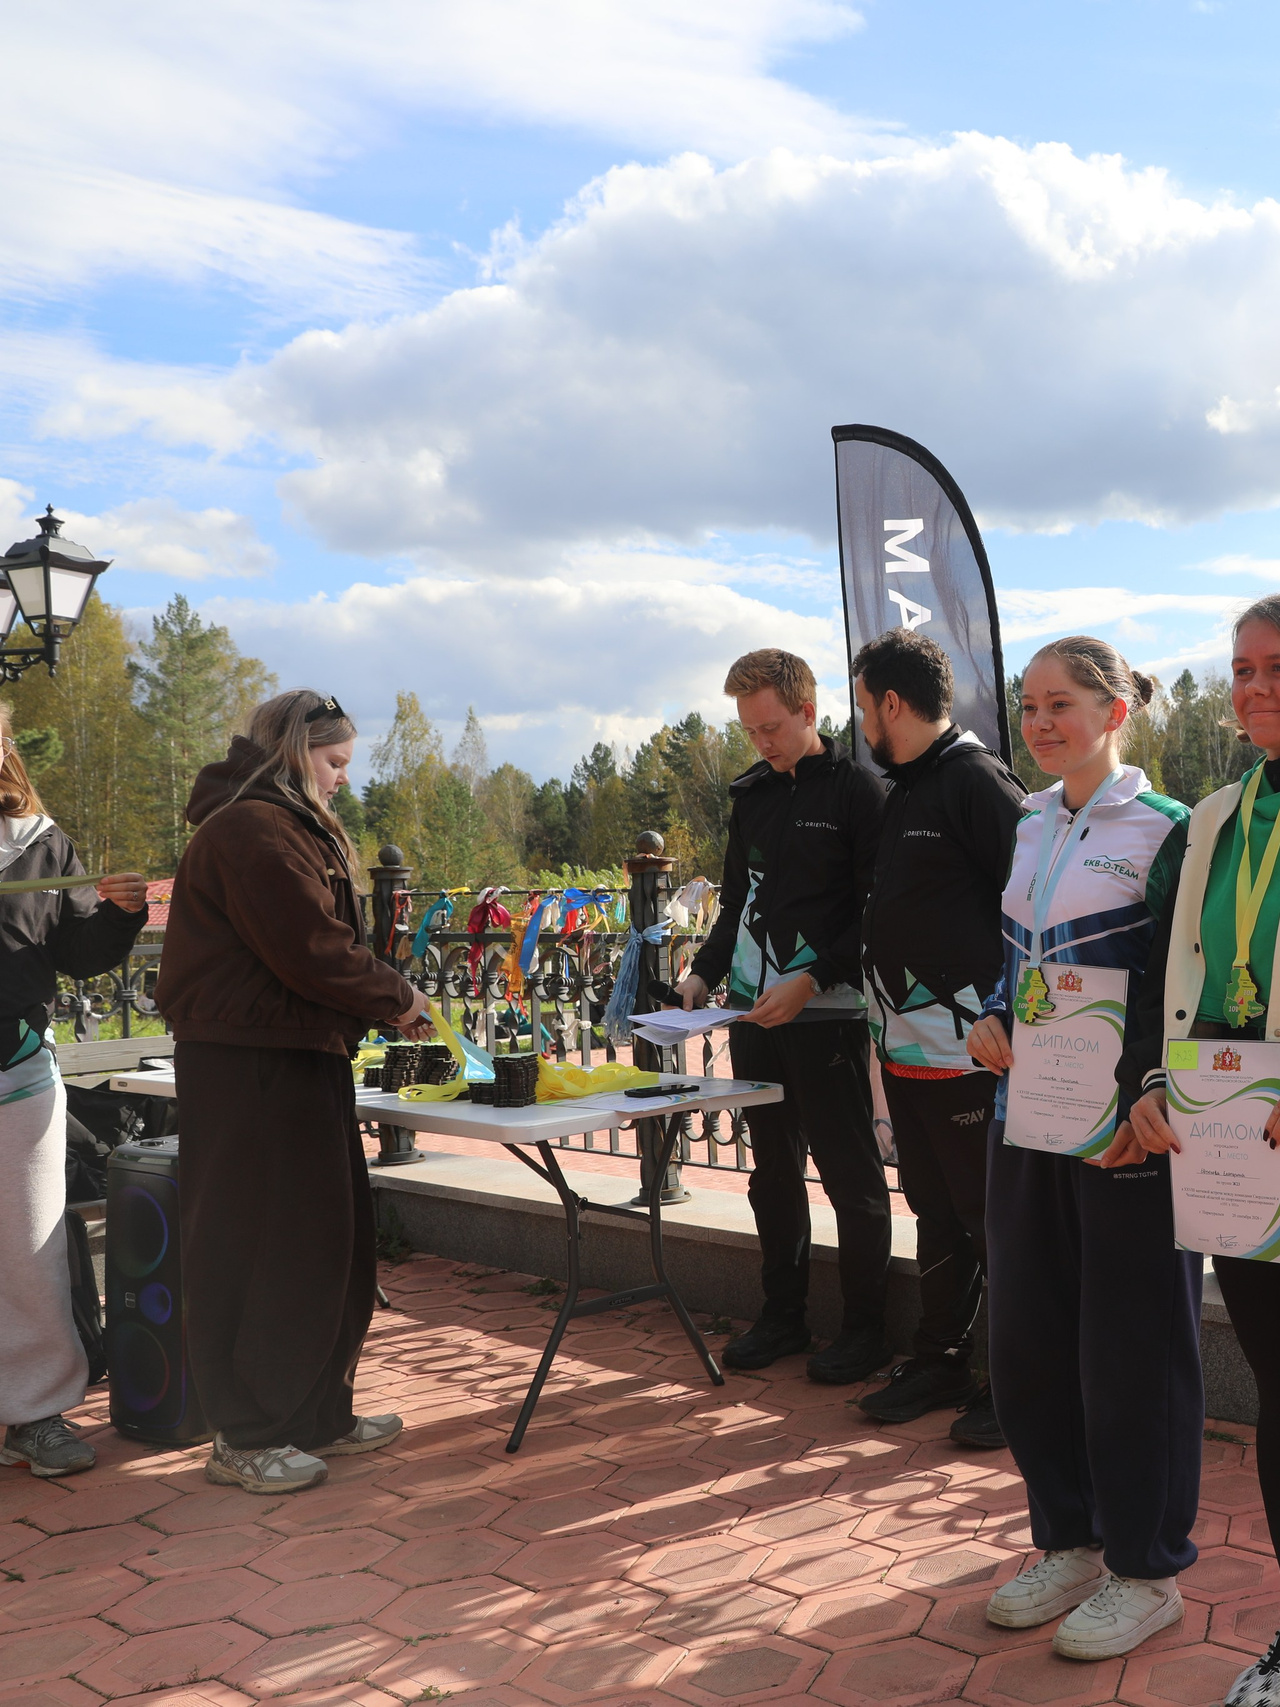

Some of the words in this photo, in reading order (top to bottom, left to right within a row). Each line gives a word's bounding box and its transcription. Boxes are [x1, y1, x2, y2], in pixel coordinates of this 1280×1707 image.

[1083, 859, 1139, 880] EKB-O-TEAM
[1031, 1033, 1099, 1054] ДИПЛОМ
[1189, 1122, 1263, 1141] ДИПЛОМ
[1226, 1152, 1249, 1161] МЕСТО
